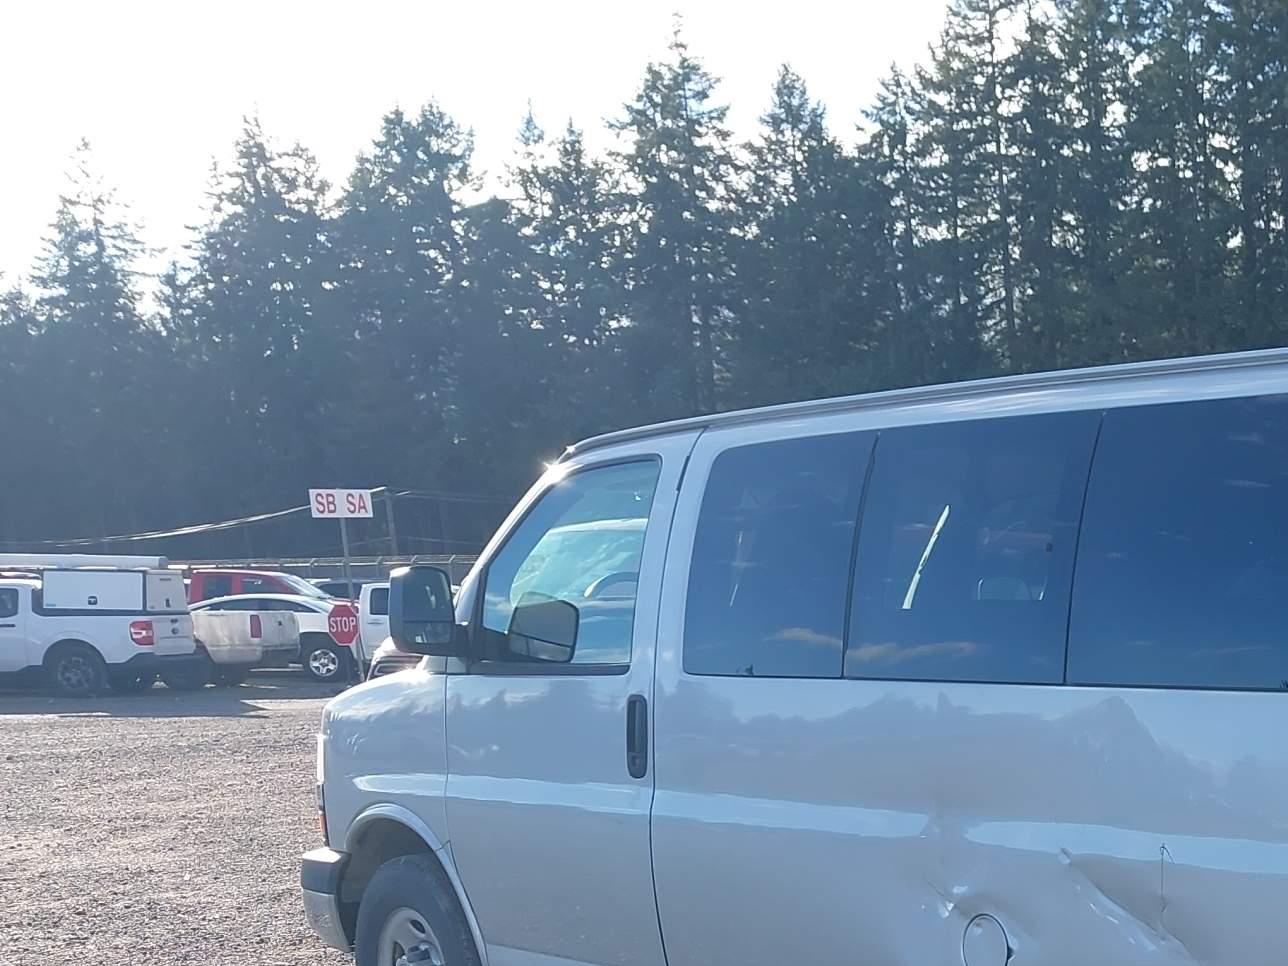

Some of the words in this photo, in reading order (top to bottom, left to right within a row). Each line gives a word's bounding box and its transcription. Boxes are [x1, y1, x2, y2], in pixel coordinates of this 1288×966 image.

[315, 493, 337, 514] SB
[346, 493, 368, 514] SA
[330, 616, 356, 633] STOP
